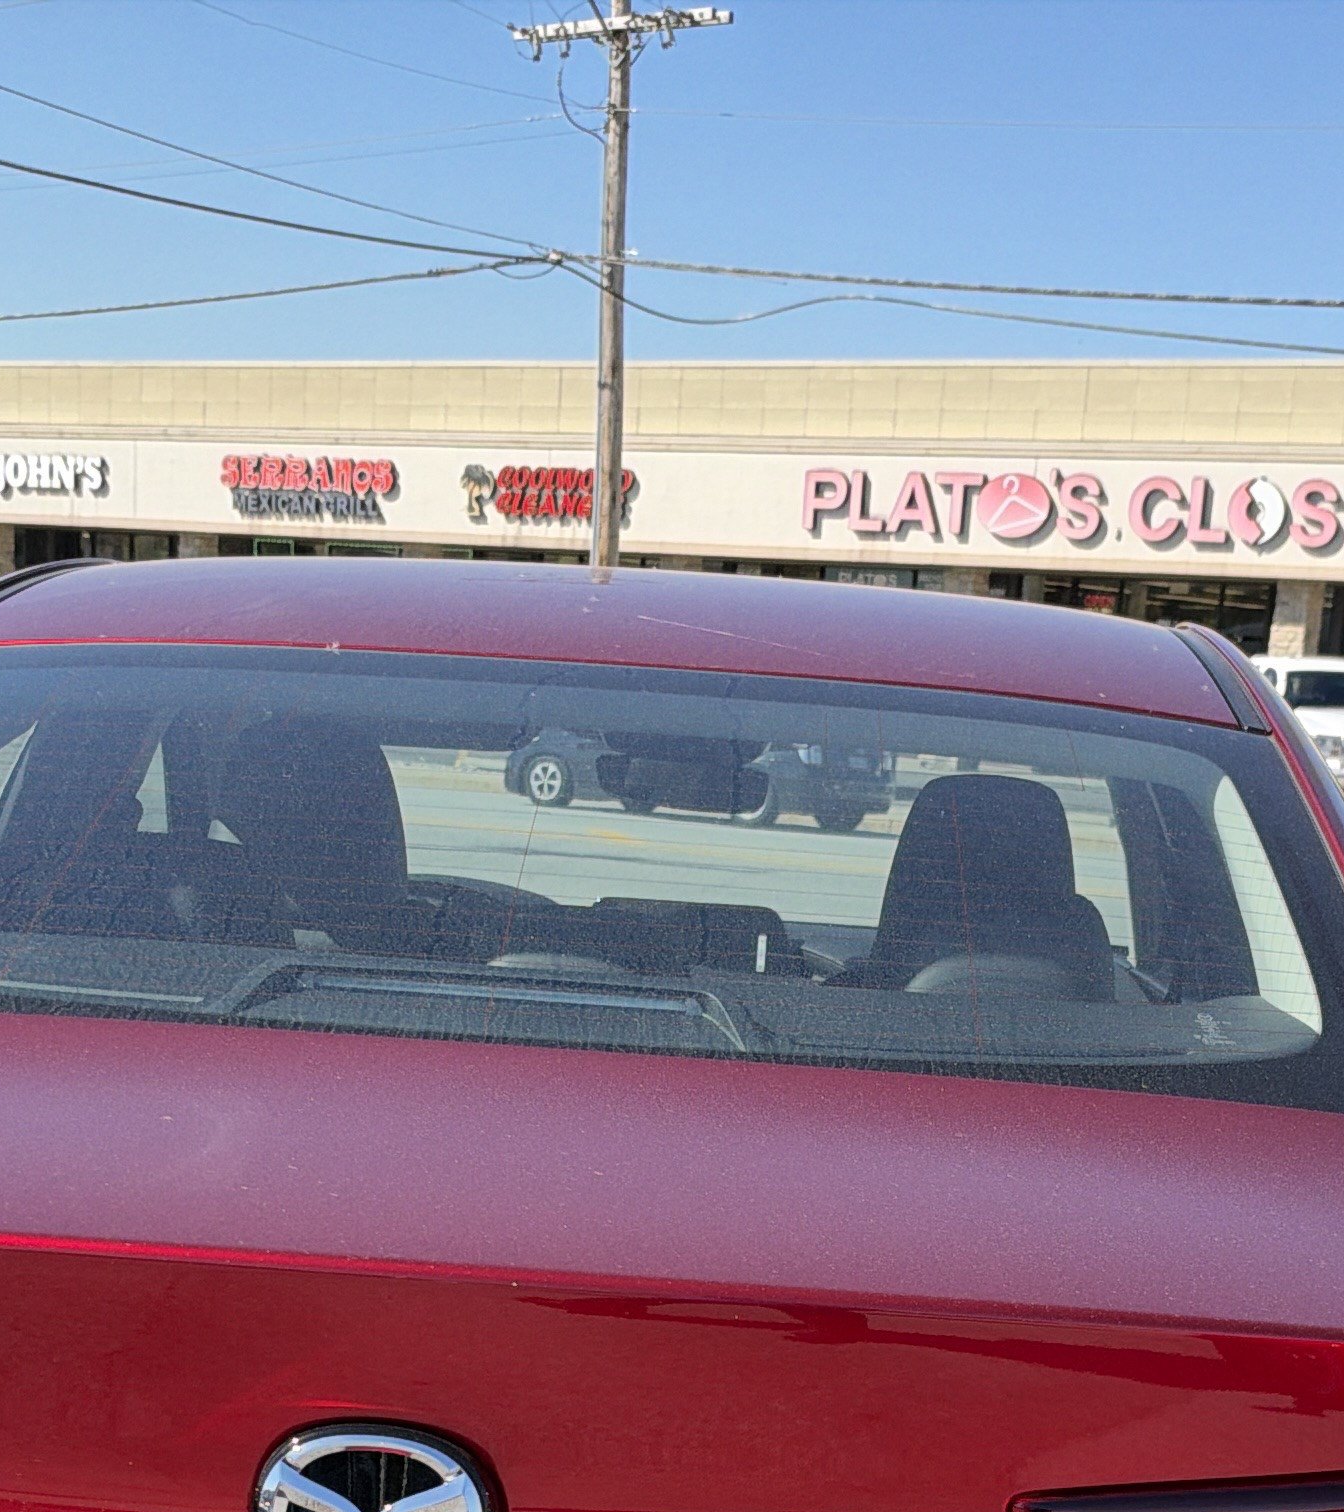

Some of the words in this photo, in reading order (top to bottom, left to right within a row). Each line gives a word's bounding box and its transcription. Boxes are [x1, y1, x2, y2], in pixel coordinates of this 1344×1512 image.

[220, 454, 394, 496] SERRANOS
[233, 488, 318, 517] MEXICAN
[323, 495, 379, 518] GRILL
[801, 468, 1102, 541] PLATO'S
